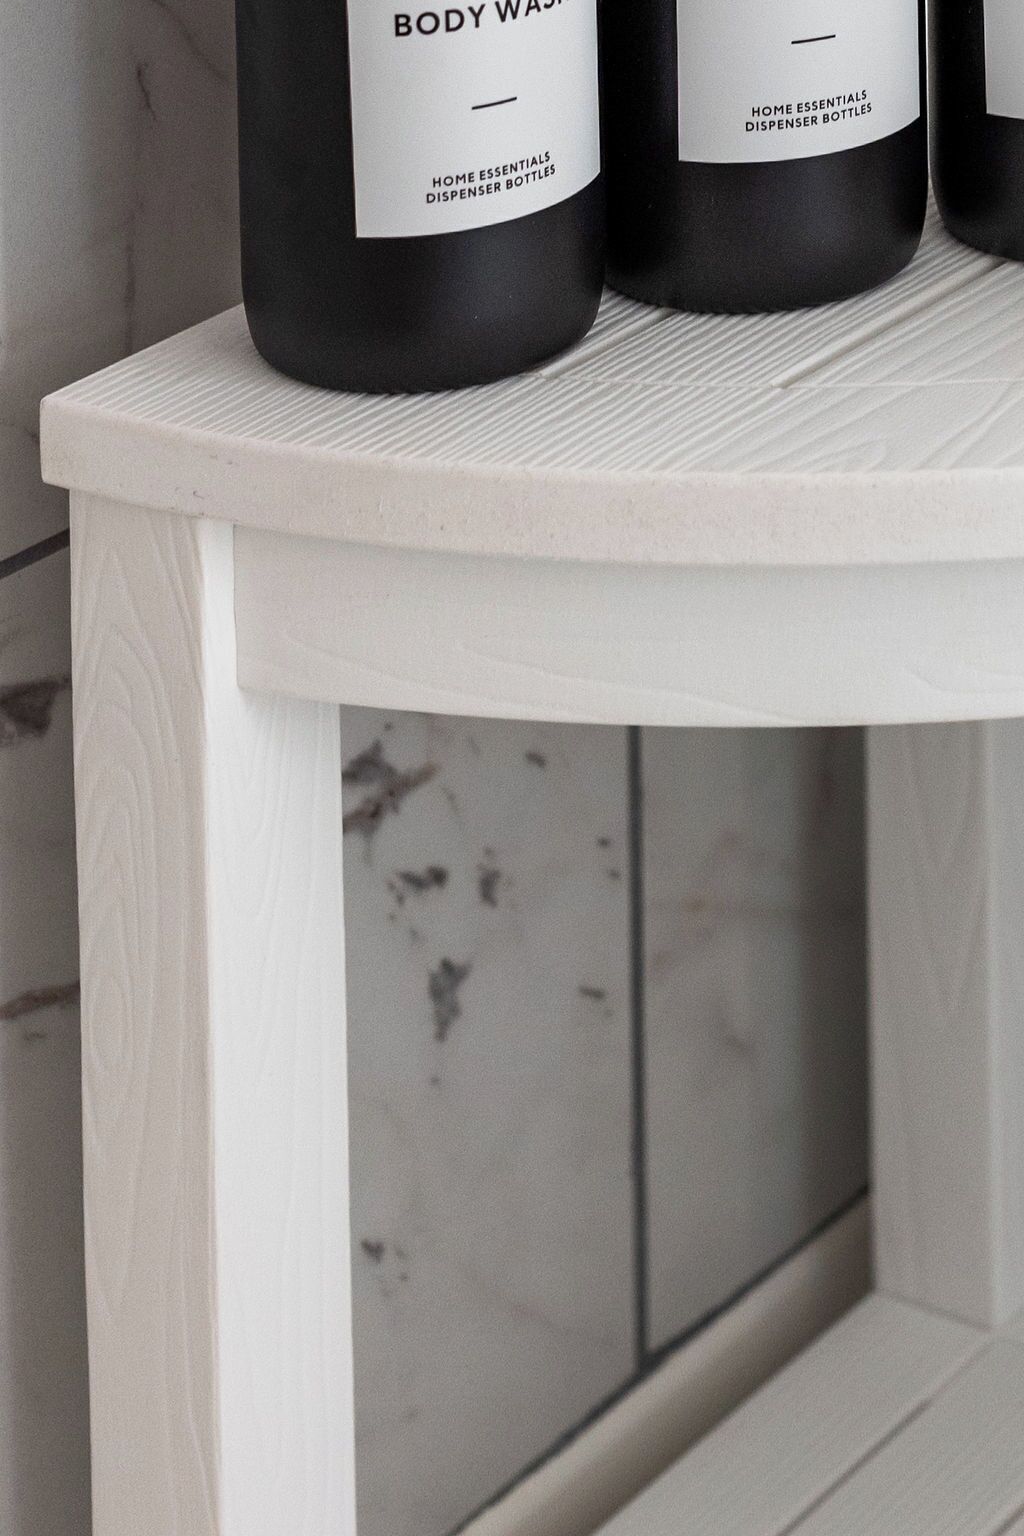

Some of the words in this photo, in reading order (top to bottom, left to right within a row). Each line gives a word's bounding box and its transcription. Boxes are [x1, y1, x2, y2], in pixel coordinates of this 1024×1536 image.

[393, 2, 487, 38] BODY
[745, 114, 819, 133] DISPENSER
[822, 101, 873, 125] BOTTLES
[751, 103, 793, 119] HOME
[796, 89, 868, 114] ESSENTIALS
[425, 180, 502, 205] DISPENSER
[505, 163, 556, 191] BOTTLES
[432, 171, 476, 189] HOME
[479, 150, 551, 182] ESSENTIALS
